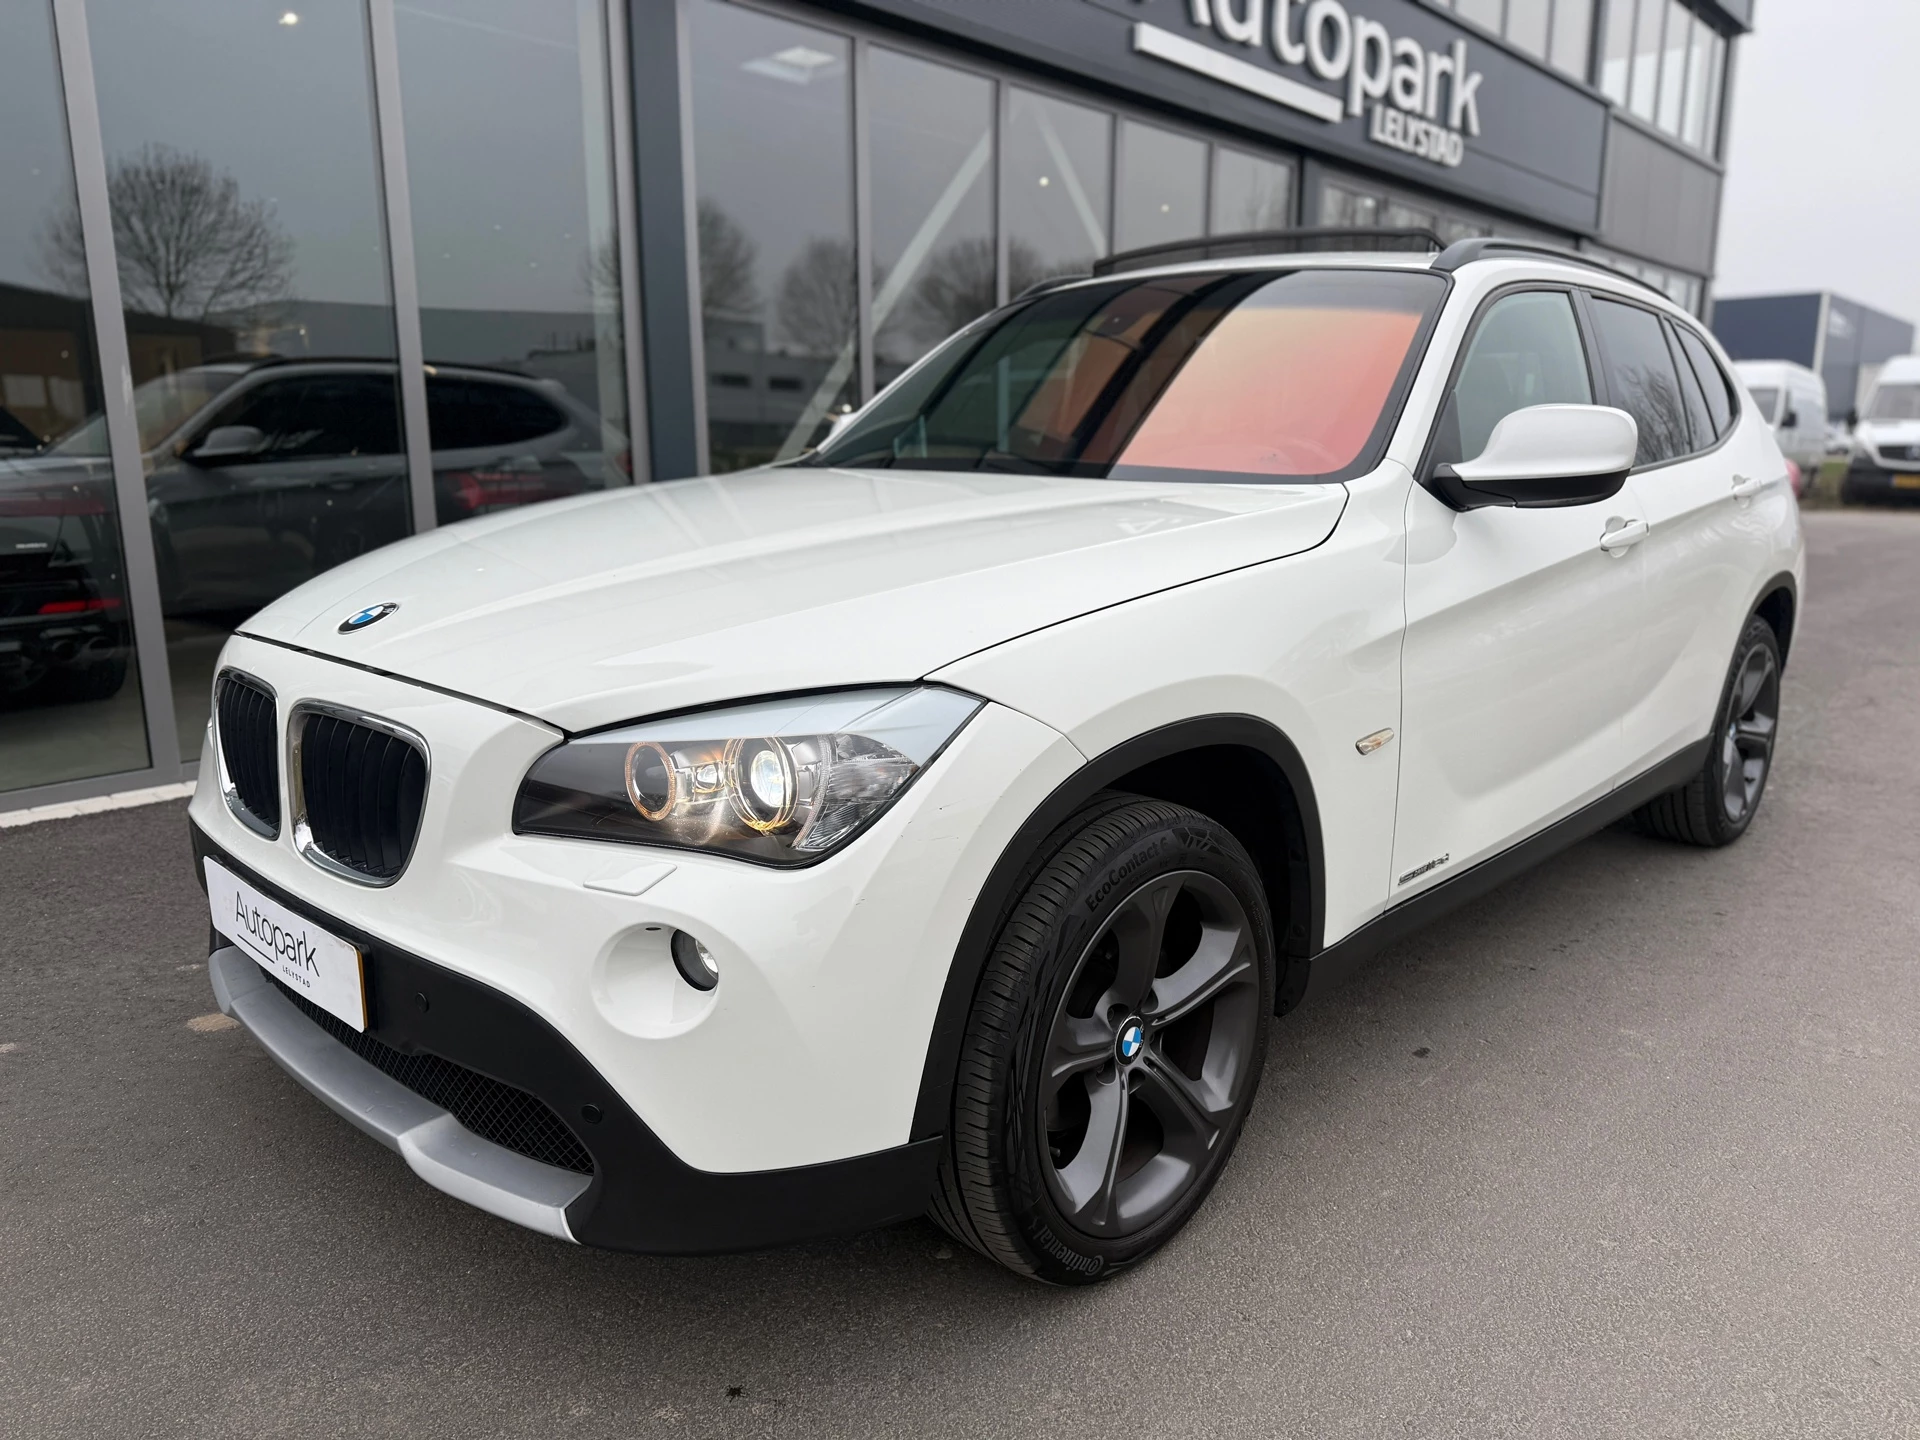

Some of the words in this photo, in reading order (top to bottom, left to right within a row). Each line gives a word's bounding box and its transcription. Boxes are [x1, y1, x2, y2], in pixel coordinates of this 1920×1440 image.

[1192, 0, 1483, 137] utopark
[1370, 103, 1464, 167] LELYSTAD
[1085, 840, 1158, 913] EcoContact
[235, 890, 320, 977] Autopark
[282, 964, 311, 989] LELYSTAD
[1033, 1224, 1104, 1276] Continental
